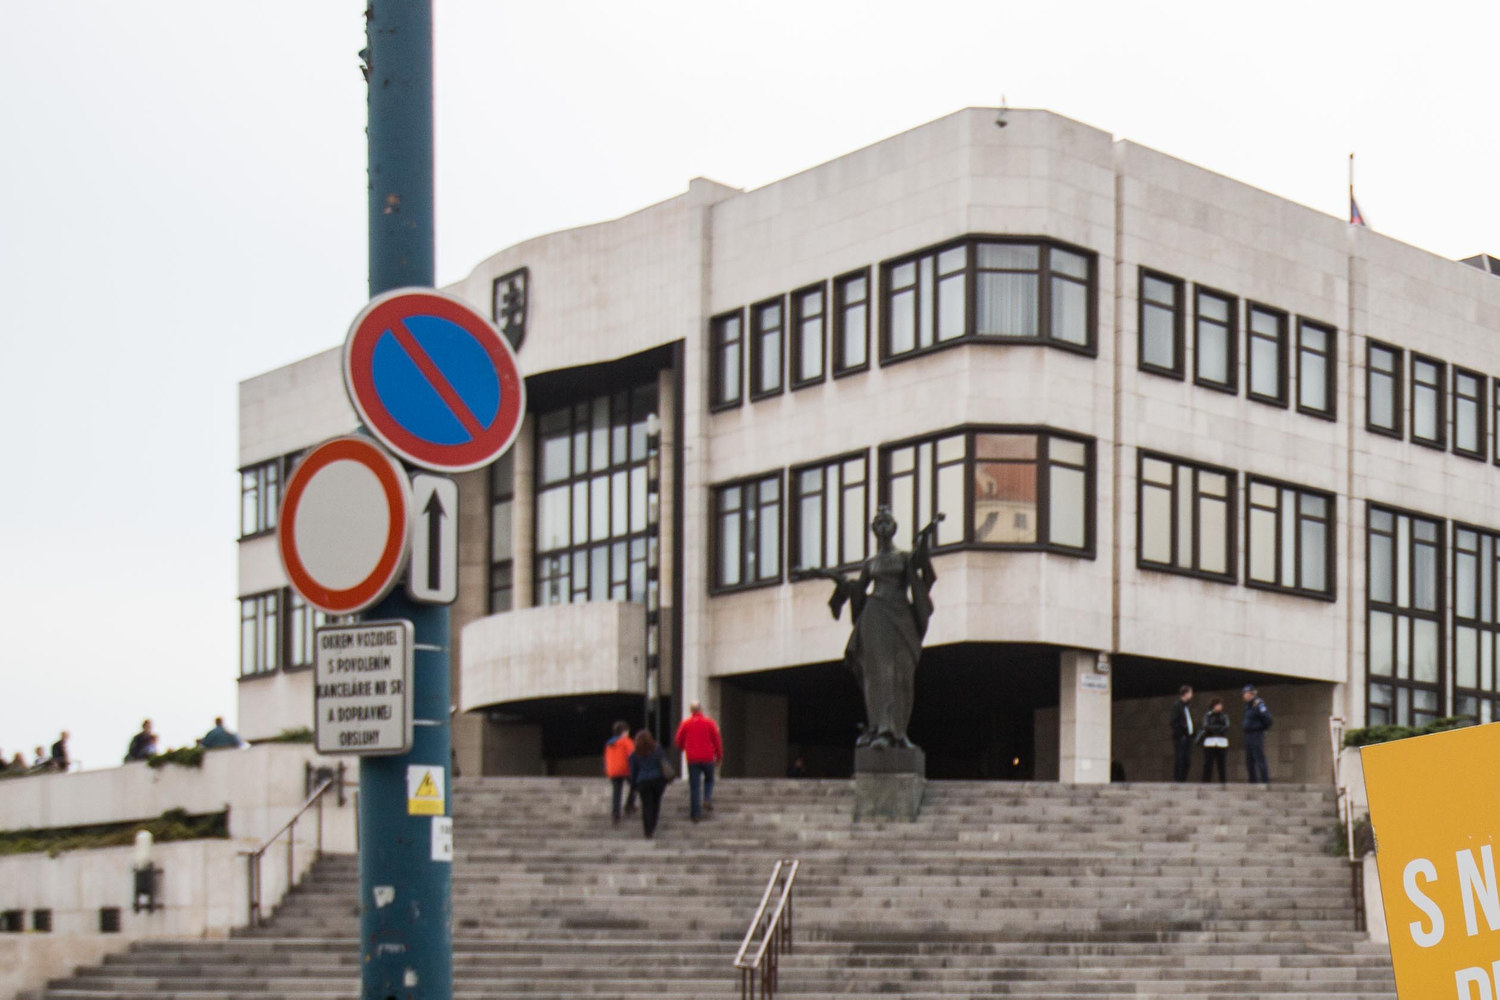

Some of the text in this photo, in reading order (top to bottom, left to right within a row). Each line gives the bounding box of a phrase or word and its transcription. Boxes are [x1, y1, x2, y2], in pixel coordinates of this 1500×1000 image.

[328, 658, 334, 674] S
[328, 704, 393, 722] A DOPRAVNEJ
[339, 730, 380, 746] OBSLUHY
[1403, 858, 1445, 948] S
